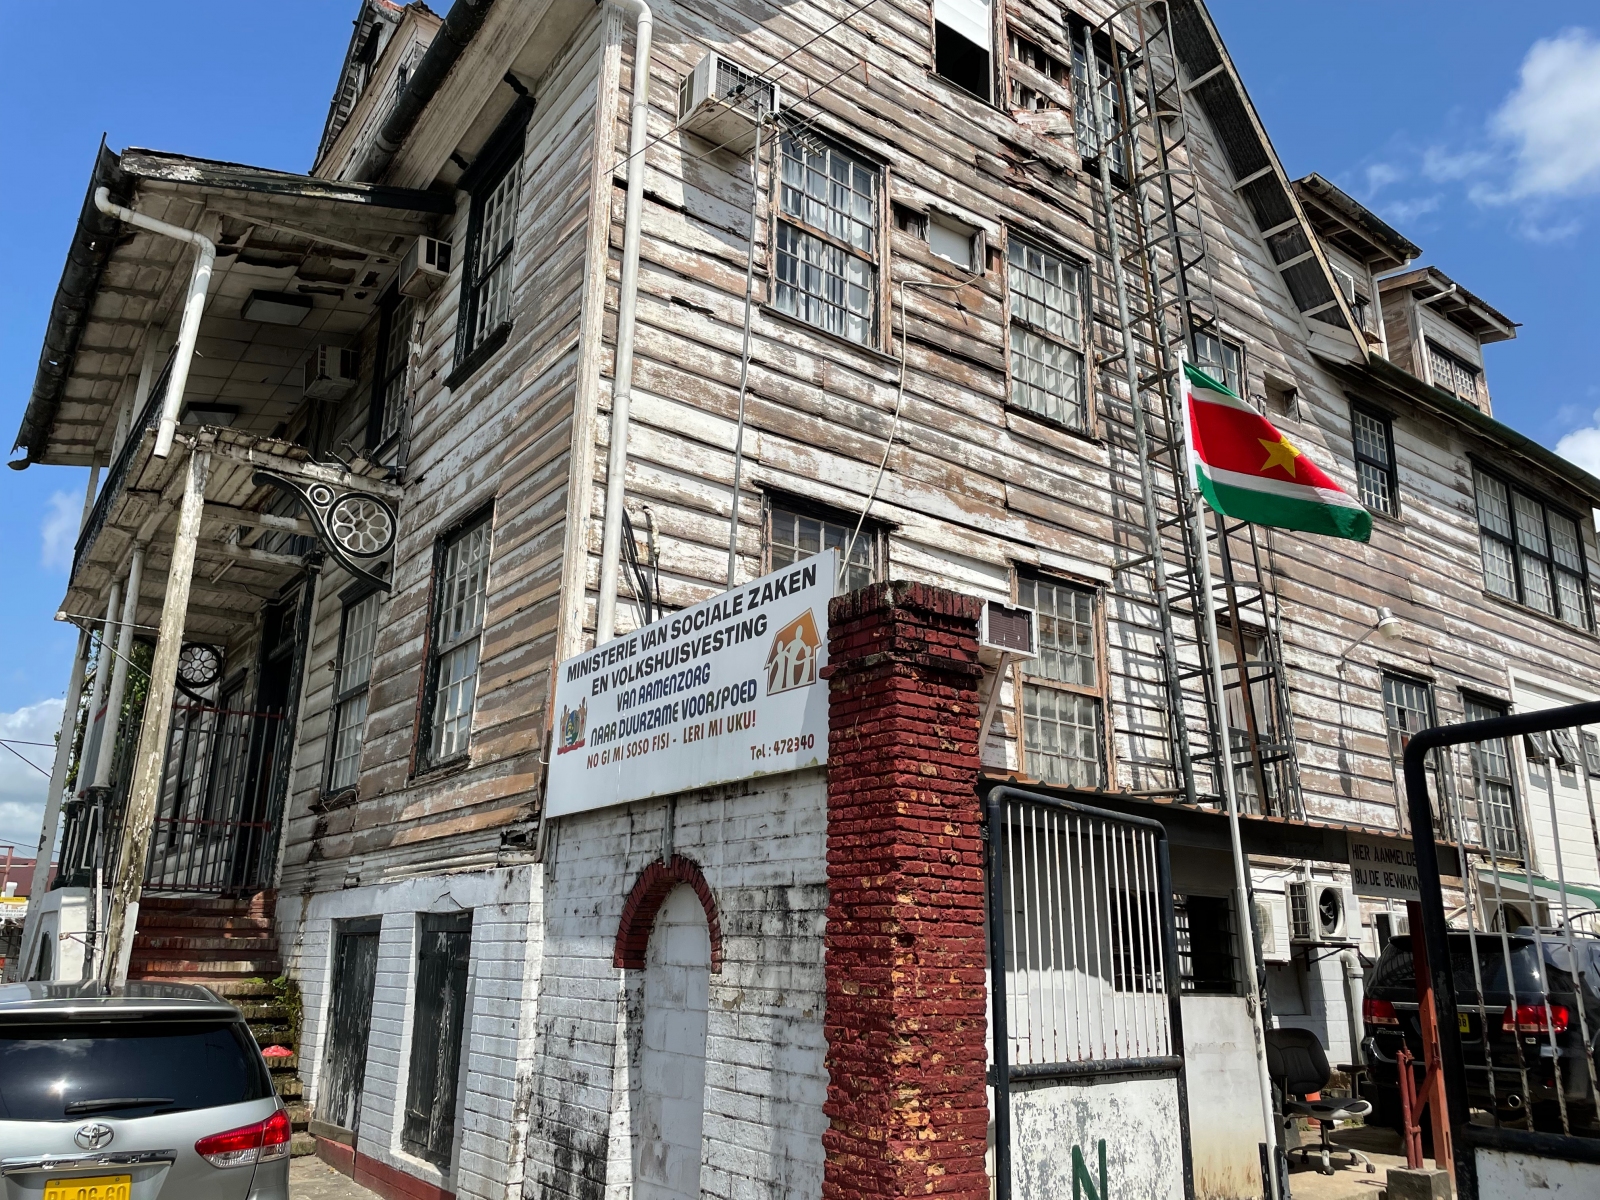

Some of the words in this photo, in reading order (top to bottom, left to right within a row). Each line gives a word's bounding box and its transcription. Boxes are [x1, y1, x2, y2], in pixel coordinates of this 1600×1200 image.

[567, 637, 637, 683] MINISTERIE
[641, 624, 668, 652] VAN
[671, 593, 743, 640] SOCIALE
[747, 564, 816, 611] ZAKEN
[592, 674, 608, 697] EN
[612, 613, 767, 689] VOLKSHUISVESTING
[590, 721, 617, 747] NAAR
[618, 701, 679, 739] DUURZAME
[682, 679, 757, 721] VOORSPOED
[617, 688, 636, 713] VAN
[638, 662, 711, 706] ARMENZORG
[587, 752, 599, 770] NO
[601, 749, 610, 766] GI
[612, 745, 624, 763] MI
[626, 738, 649, 759] SOSO
[652, 732, 670, 752] FISI
[683, 722, 705, 744] LERI
[708, 718, 723, 738] MI
[727, 709, 756, 734] UKU!
[773, 733, 815, 756] 472340
[1352, 844, 1371, 861] HIER
[1374, 846, 1416, 867] AANMELDE
[1354, 869, 1367, 885] BIJ
[1368, 871, 1381, 887] DE
[1384, 872, 1420, 890] BEWAKIN
